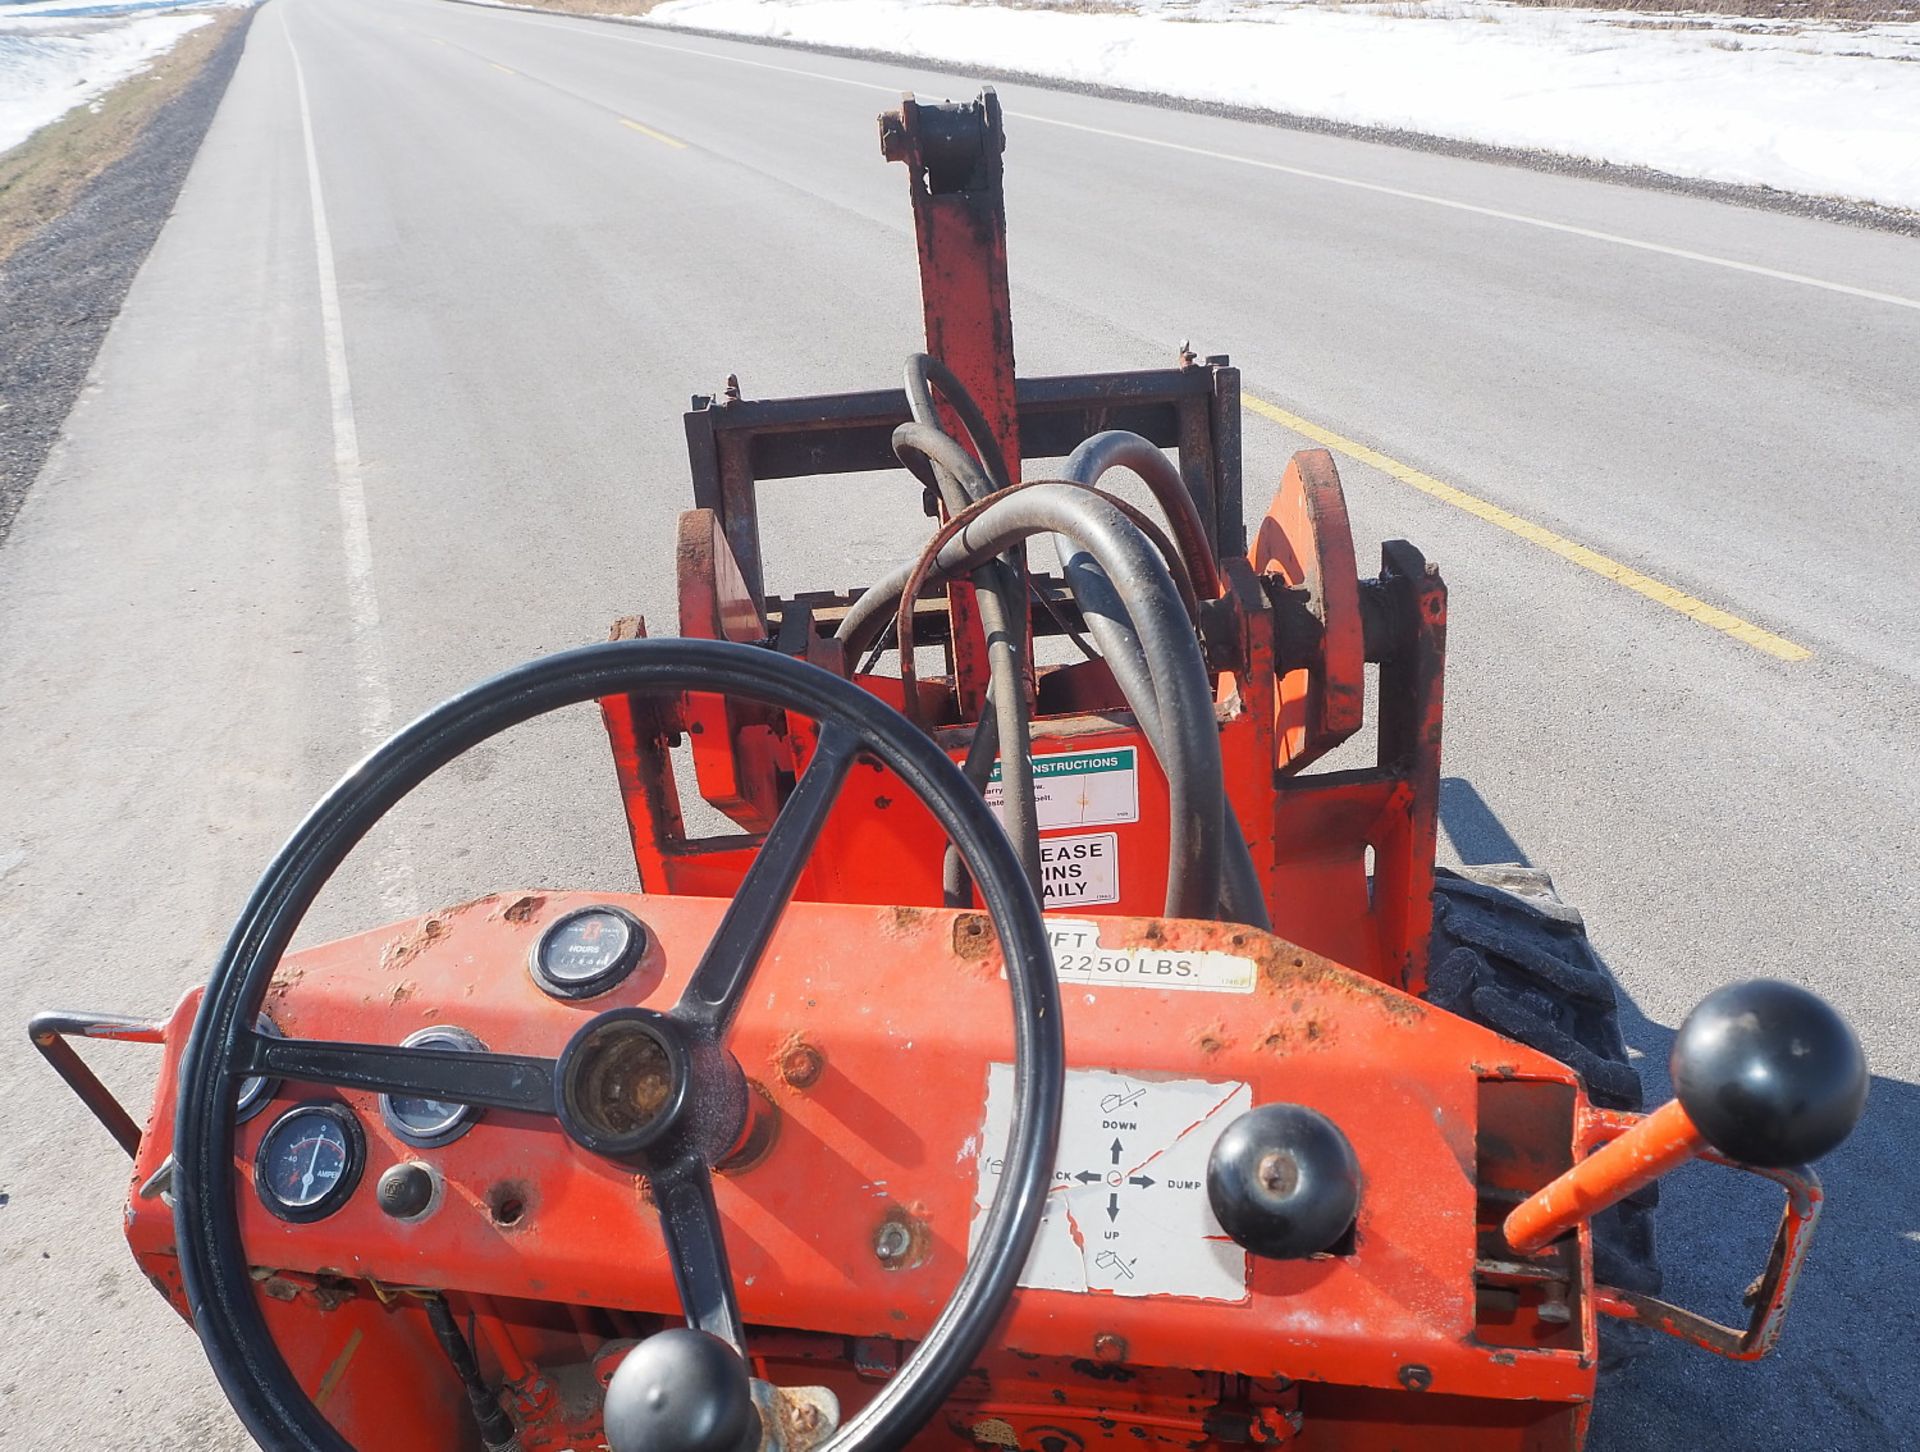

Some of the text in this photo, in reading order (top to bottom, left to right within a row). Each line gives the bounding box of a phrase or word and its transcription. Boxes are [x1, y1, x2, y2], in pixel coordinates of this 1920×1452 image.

[1032, 757, 1119, 774] NSTRUCTIONS
[1041, 843, 1103, 862] EASE
[1044, 864, 1082, 881] INS
[1043, 882, 1088, 898] AILY
[1048, 931, 1088, 948] IFT
[568, 944, 600, 953] HOURS
[1059, 954, 1199, 977] 2250 LBS.
[1102, 1120, 1138, 1131] DOWN
[1055, 1171, 1072, 1181] CK
[1167, 1180, 1202, 1190] DUMP
[1104, 1231, 1120, 1240] UP
